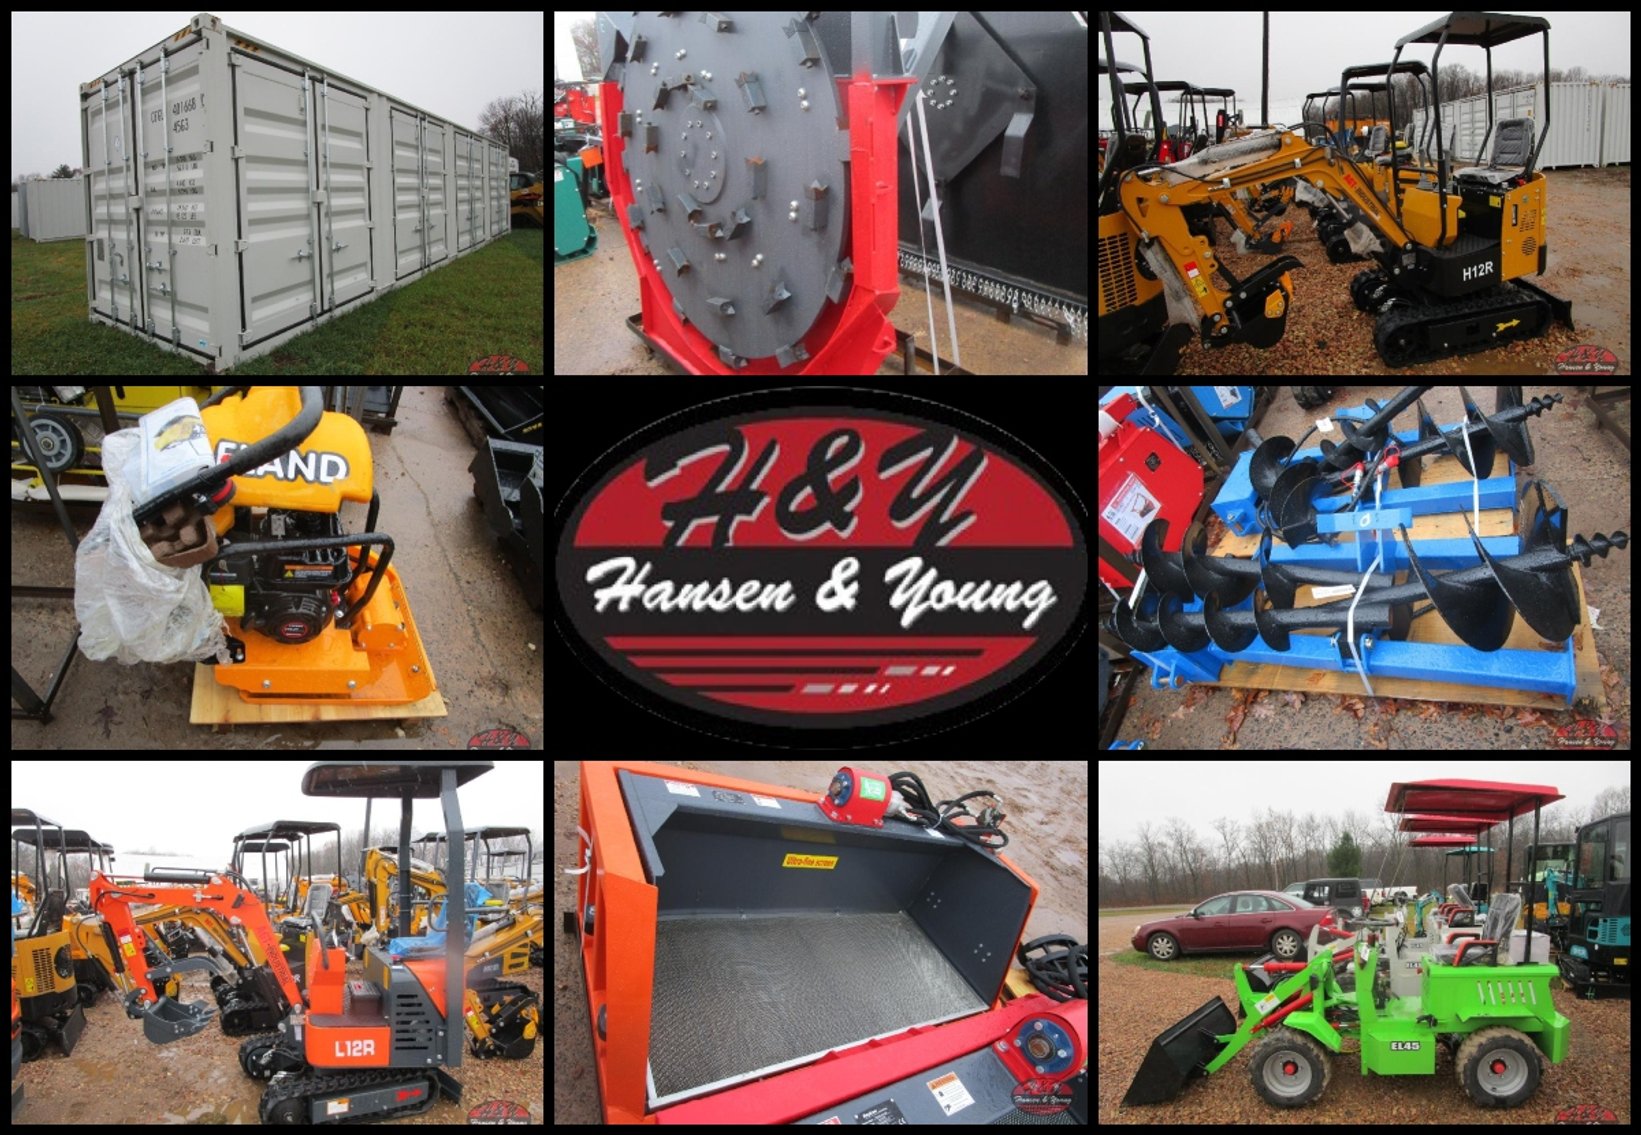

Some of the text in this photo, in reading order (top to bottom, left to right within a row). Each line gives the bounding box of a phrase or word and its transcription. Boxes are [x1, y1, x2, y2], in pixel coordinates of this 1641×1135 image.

[1463, 261, 1494, 281] H12R
[334, 1039, 376, 1057] L12R
[1391, 1041, 1420, 1051] EL45
